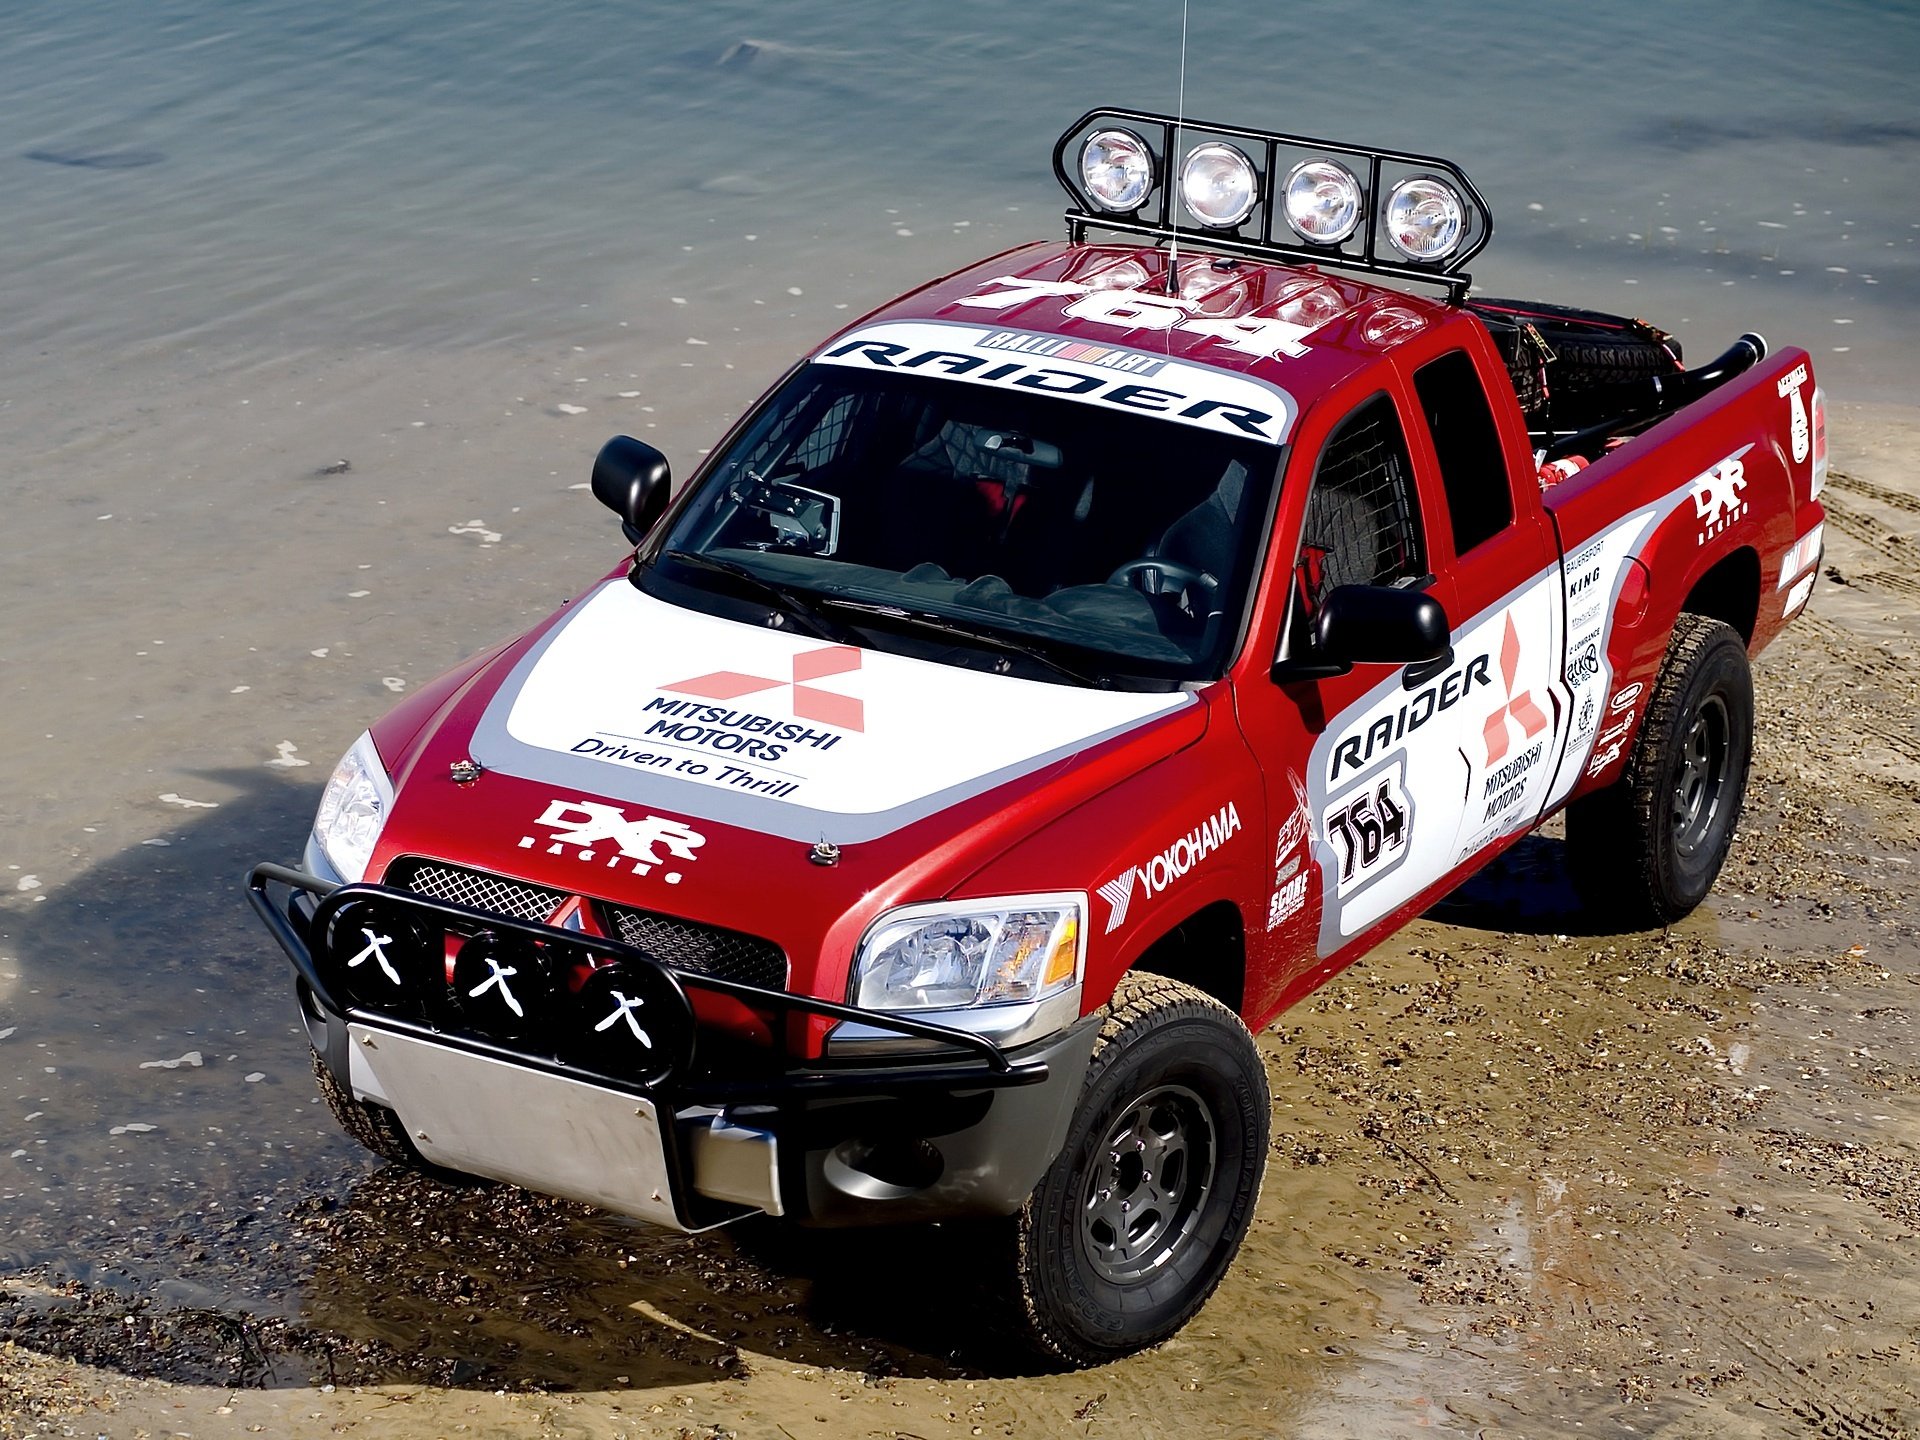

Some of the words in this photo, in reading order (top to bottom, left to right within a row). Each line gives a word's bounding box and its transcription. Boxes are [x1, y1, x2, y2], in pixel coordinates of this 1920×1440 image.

[954, 275, 1315, 363] 764
[827, 339, 1274, 441] RAIDER
[1698, 502, 1748, 546] RACING
[1570, 567, 1600, 598] KING
[642, 697, 841, 752] MITSUBISHI
[645, 719, 788, 762] MOTORS
[1330, 654, 1491, 782] RAIDER
[570, 737, 673, 771] Driven
[675, 758, 708, 775] to
[714, 767, 799, 798] Thrill
[1484, 741, 1543, 800] MITSUBISHI
[1483, 777, 1527, 823] MOTORS
[517, 835, 683, 884] RACING
[534, 799, 706, 865] DXR
[1136, 801, 1242, 900] YOKOHAMA
[1326, 778, 1407, 884] 764
[1270, 870, 1309, 917] SCORE
